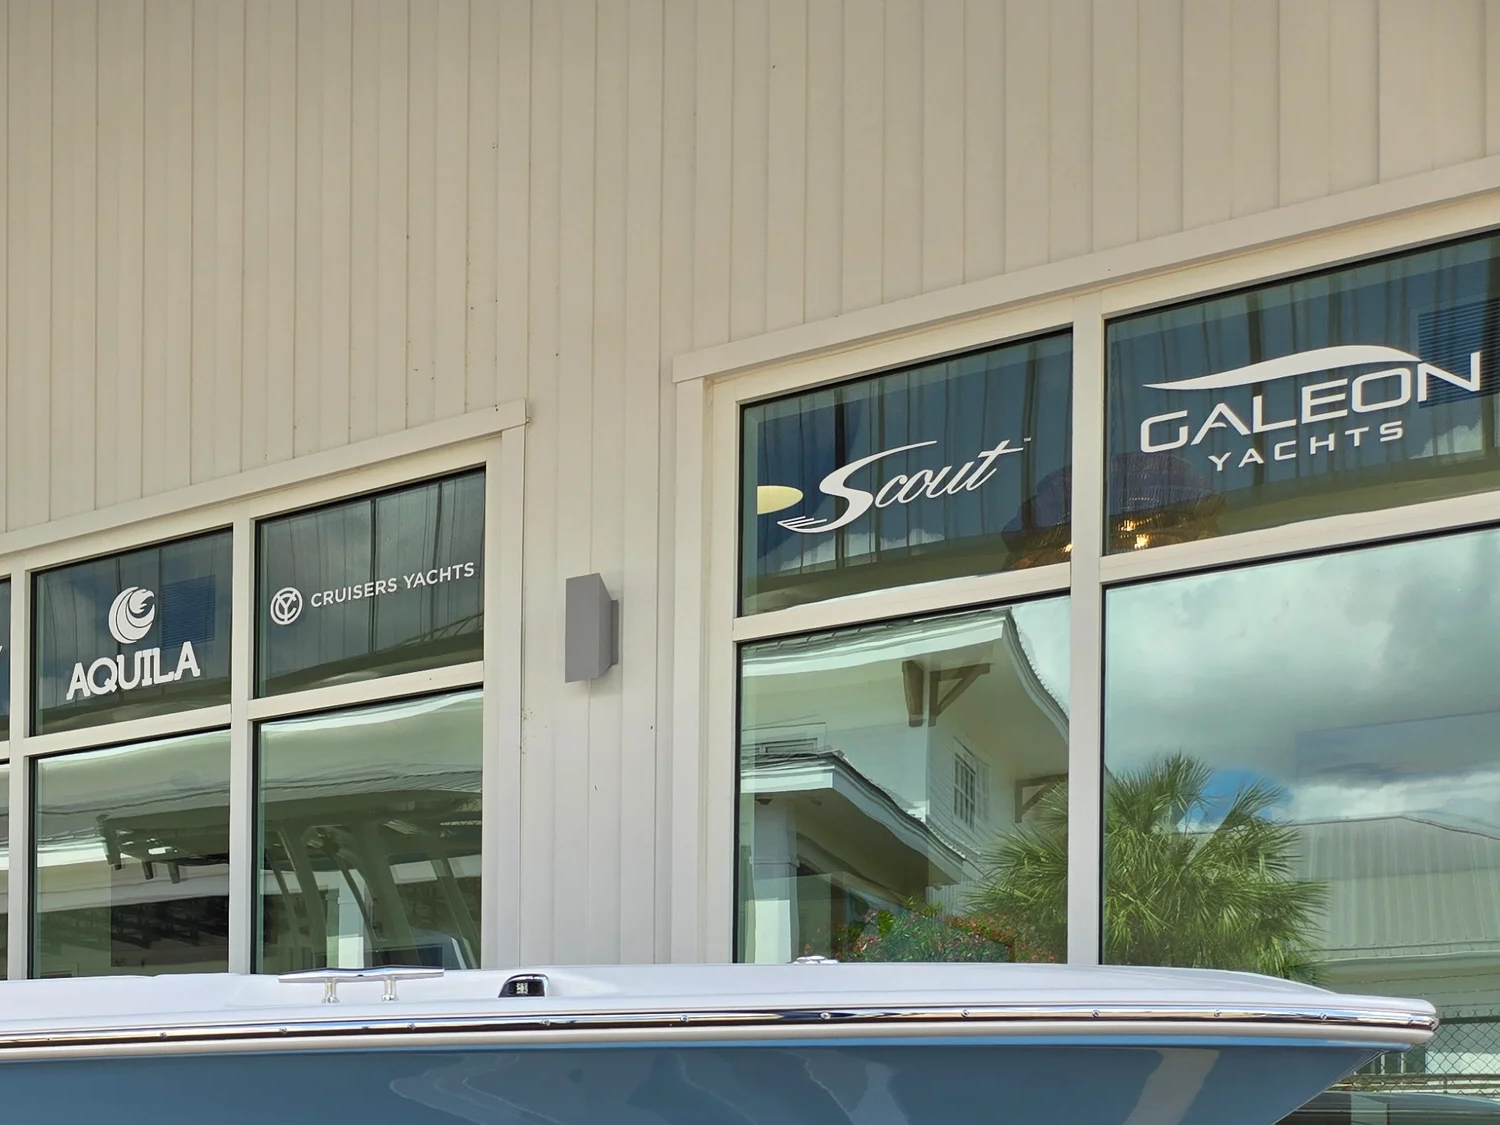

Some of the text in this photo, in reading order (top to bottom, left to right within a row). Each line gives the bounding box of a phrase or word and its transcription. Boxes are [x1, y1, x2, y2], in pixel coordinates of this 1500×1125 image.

[1140, 351, 1481, 453] GALEON
[1207, 420, 1404, 472] YACHTS
[777, 439, 1024, 533] Scout
[310, 562, 475, 608] CRUISERS YACHTS
[66, 641, 200, 700] AQUILA
